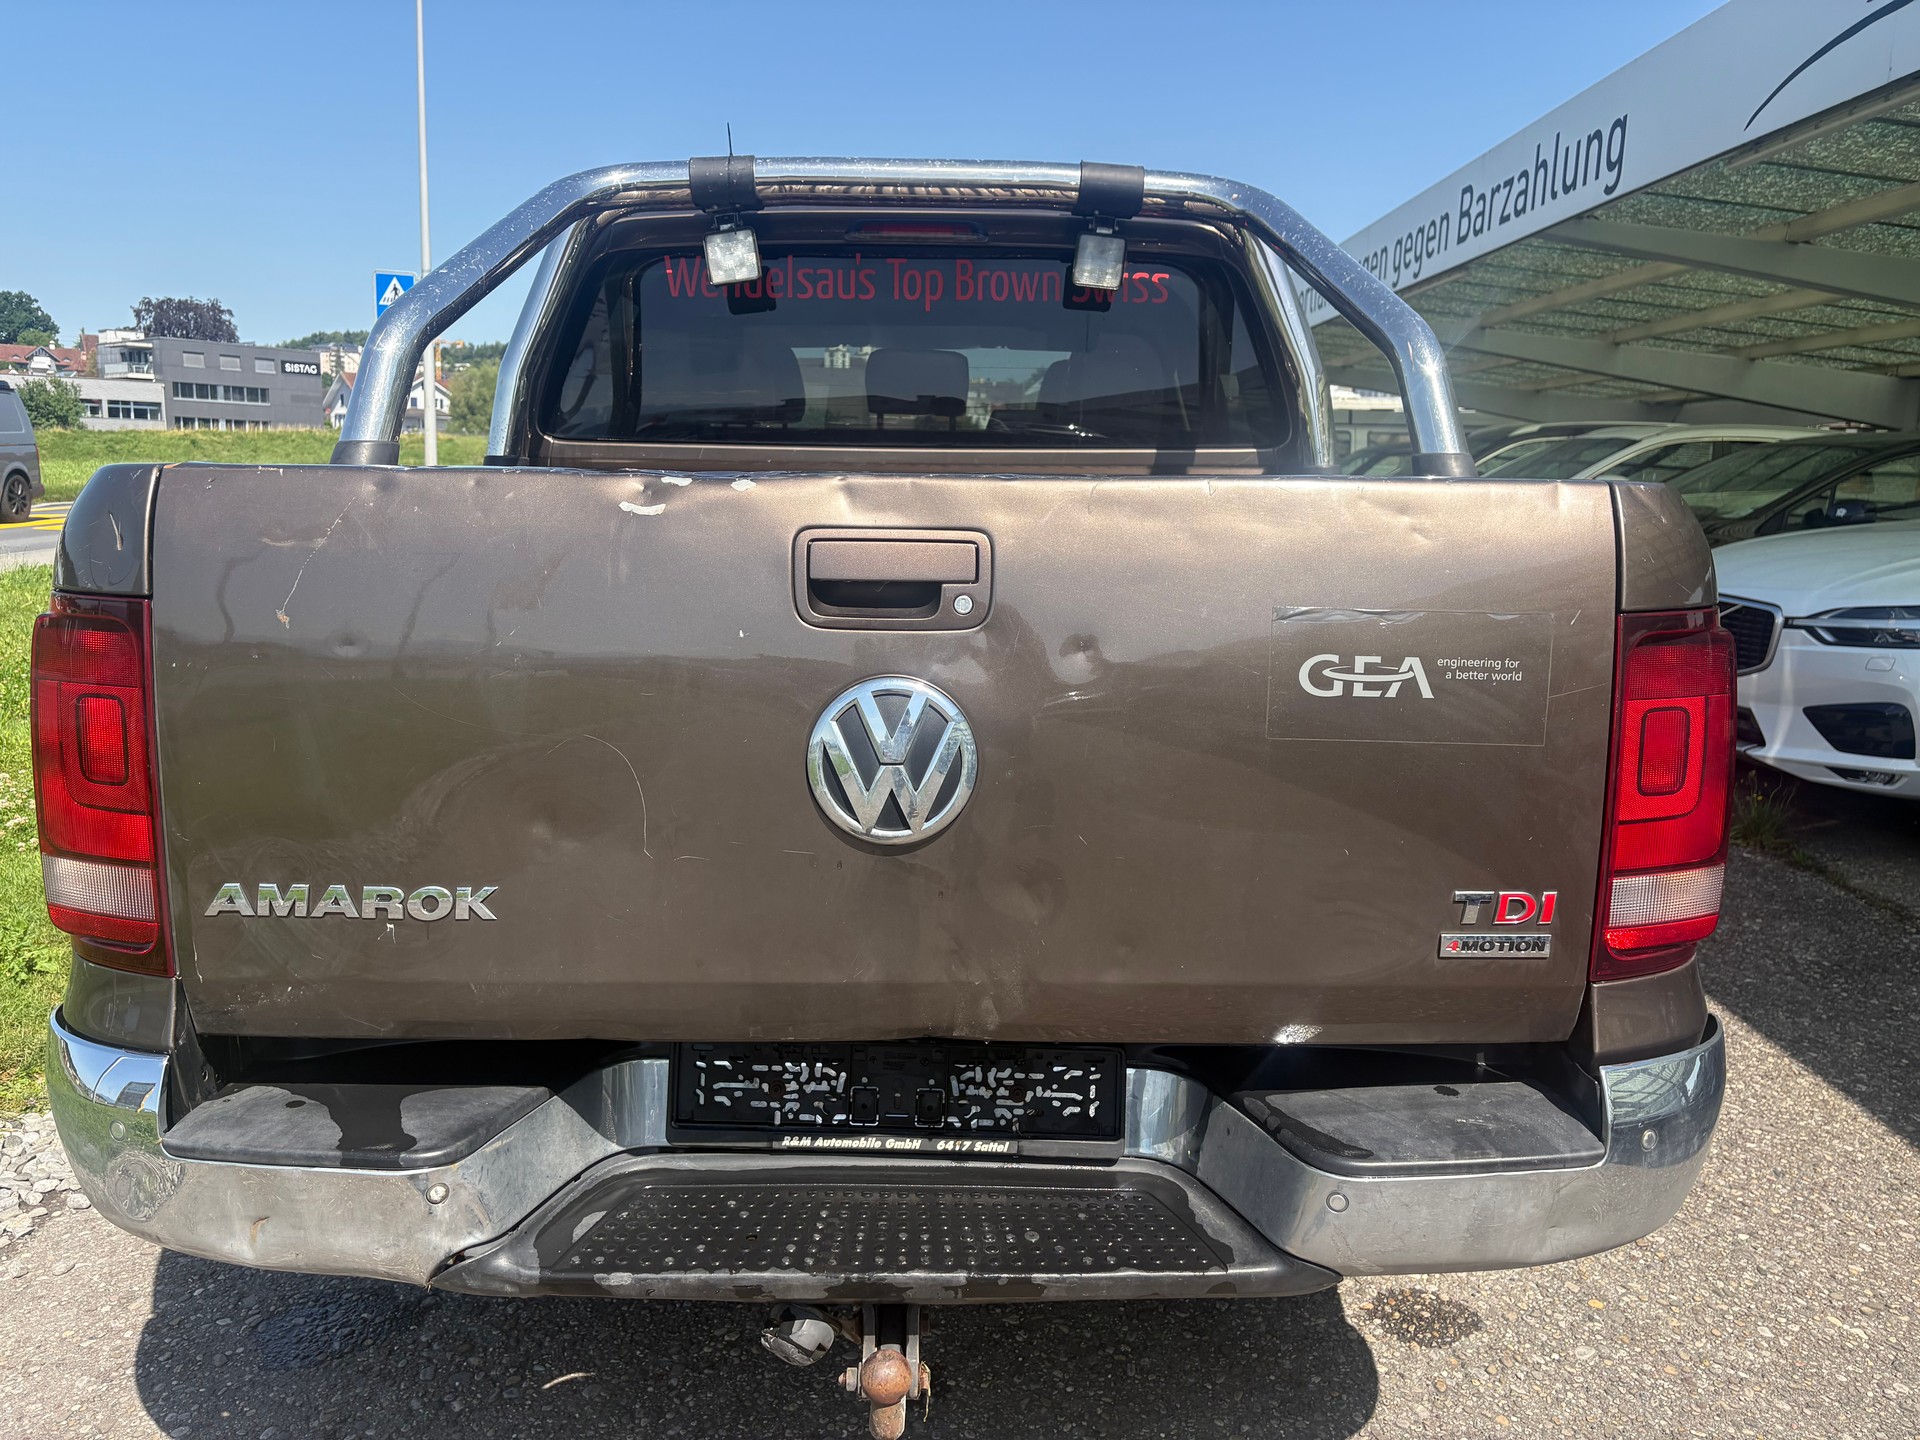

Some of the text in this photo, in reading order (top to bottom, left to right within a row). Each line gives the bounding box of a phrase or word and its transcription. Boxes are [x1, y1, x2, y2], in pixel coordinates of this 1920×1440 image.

[1392, 212, 1450, 288] gegen
[1456, 113, 1628, 246] Barzahlung
[886, 258, 944, 311] Top
[955, 260, 1061, 302] Brown
[285, 362, 318, 375] SISTAG
[1299, 654, 1435, 699] GEA
[1437, 657, 1520, 670] engineering for
[1445, 669, 1522, 682] a better world
[807, 675, 978, 846] VW
[204, 882, 499, 921] AMAROK
[1453, 890, 1558, 925] TDI
[1445, 940, 1547, 953] 4MOTION
[782, 1136, 1010, 1153] R&M Automobile GmbH 6417 Sattel
